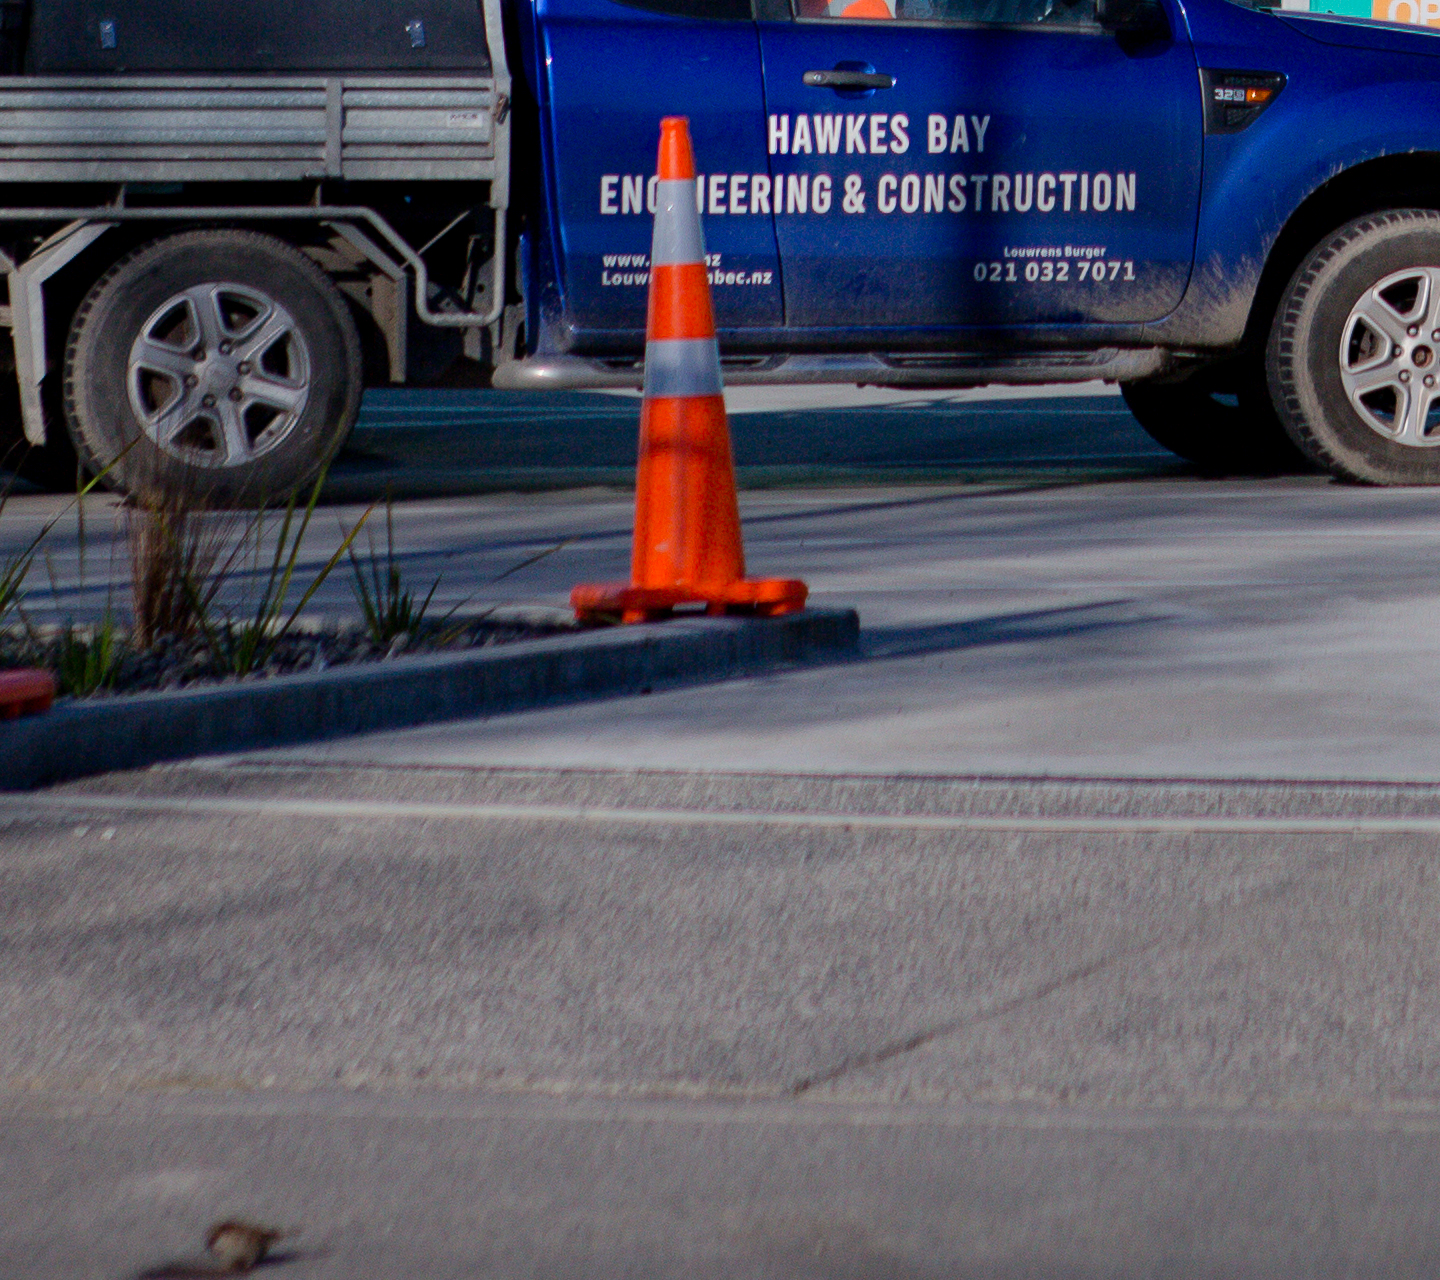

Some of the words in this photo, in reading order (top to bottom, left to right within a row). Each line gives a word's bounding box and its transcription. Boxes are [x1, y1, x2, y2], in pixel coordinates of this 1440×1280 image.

[768, 114, 910, 154] HAWKES
[927, 113, 991, 154] BAY
[842, 173, 866, 214] &
[877, 172, 1137, 214] CONSTRUCTION
[1003, 245, 1062, 258] Louwrens
[1064, 245, 1107, 260] Burger
[973, 261, 1018, 282] 021
[1025, 261, 1070, 282] 032
[1077, 261, 1136, 282] 7071
